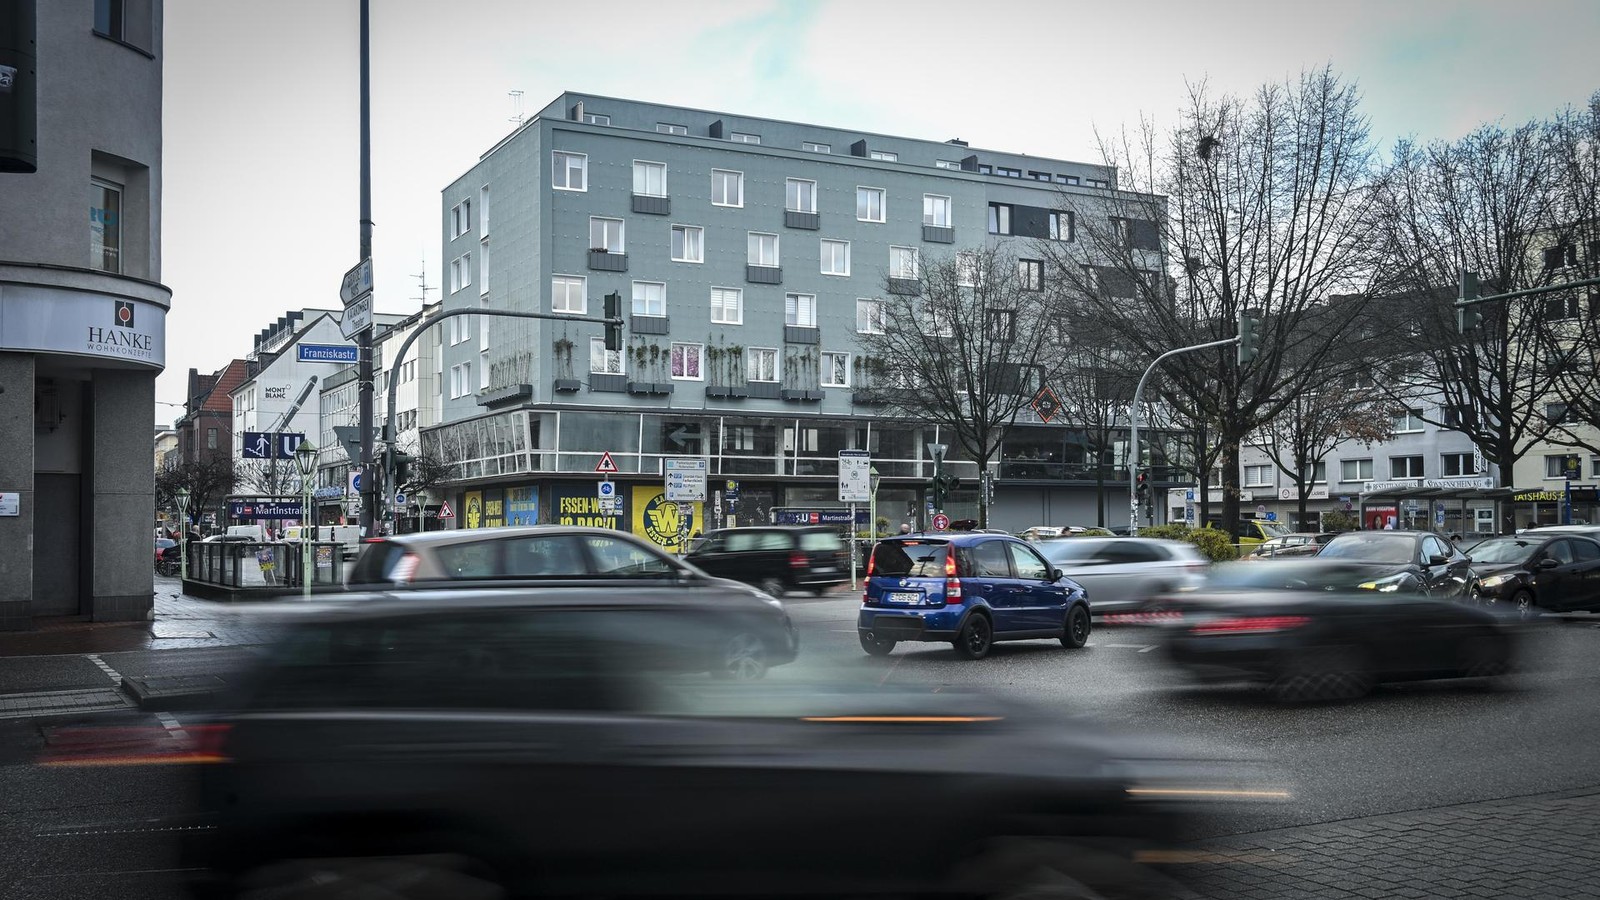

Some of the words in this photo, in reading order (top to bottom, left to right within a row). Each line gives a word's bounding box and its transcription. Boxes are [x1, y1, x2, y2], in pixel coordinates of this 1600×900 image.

[88, 326, 152, 351] HANKE
[87, 343, 152, 359] WOHNKONZEPTE
[304, 347, 356, 360] Franziskastr.
[284, 436, 300, 456] U
